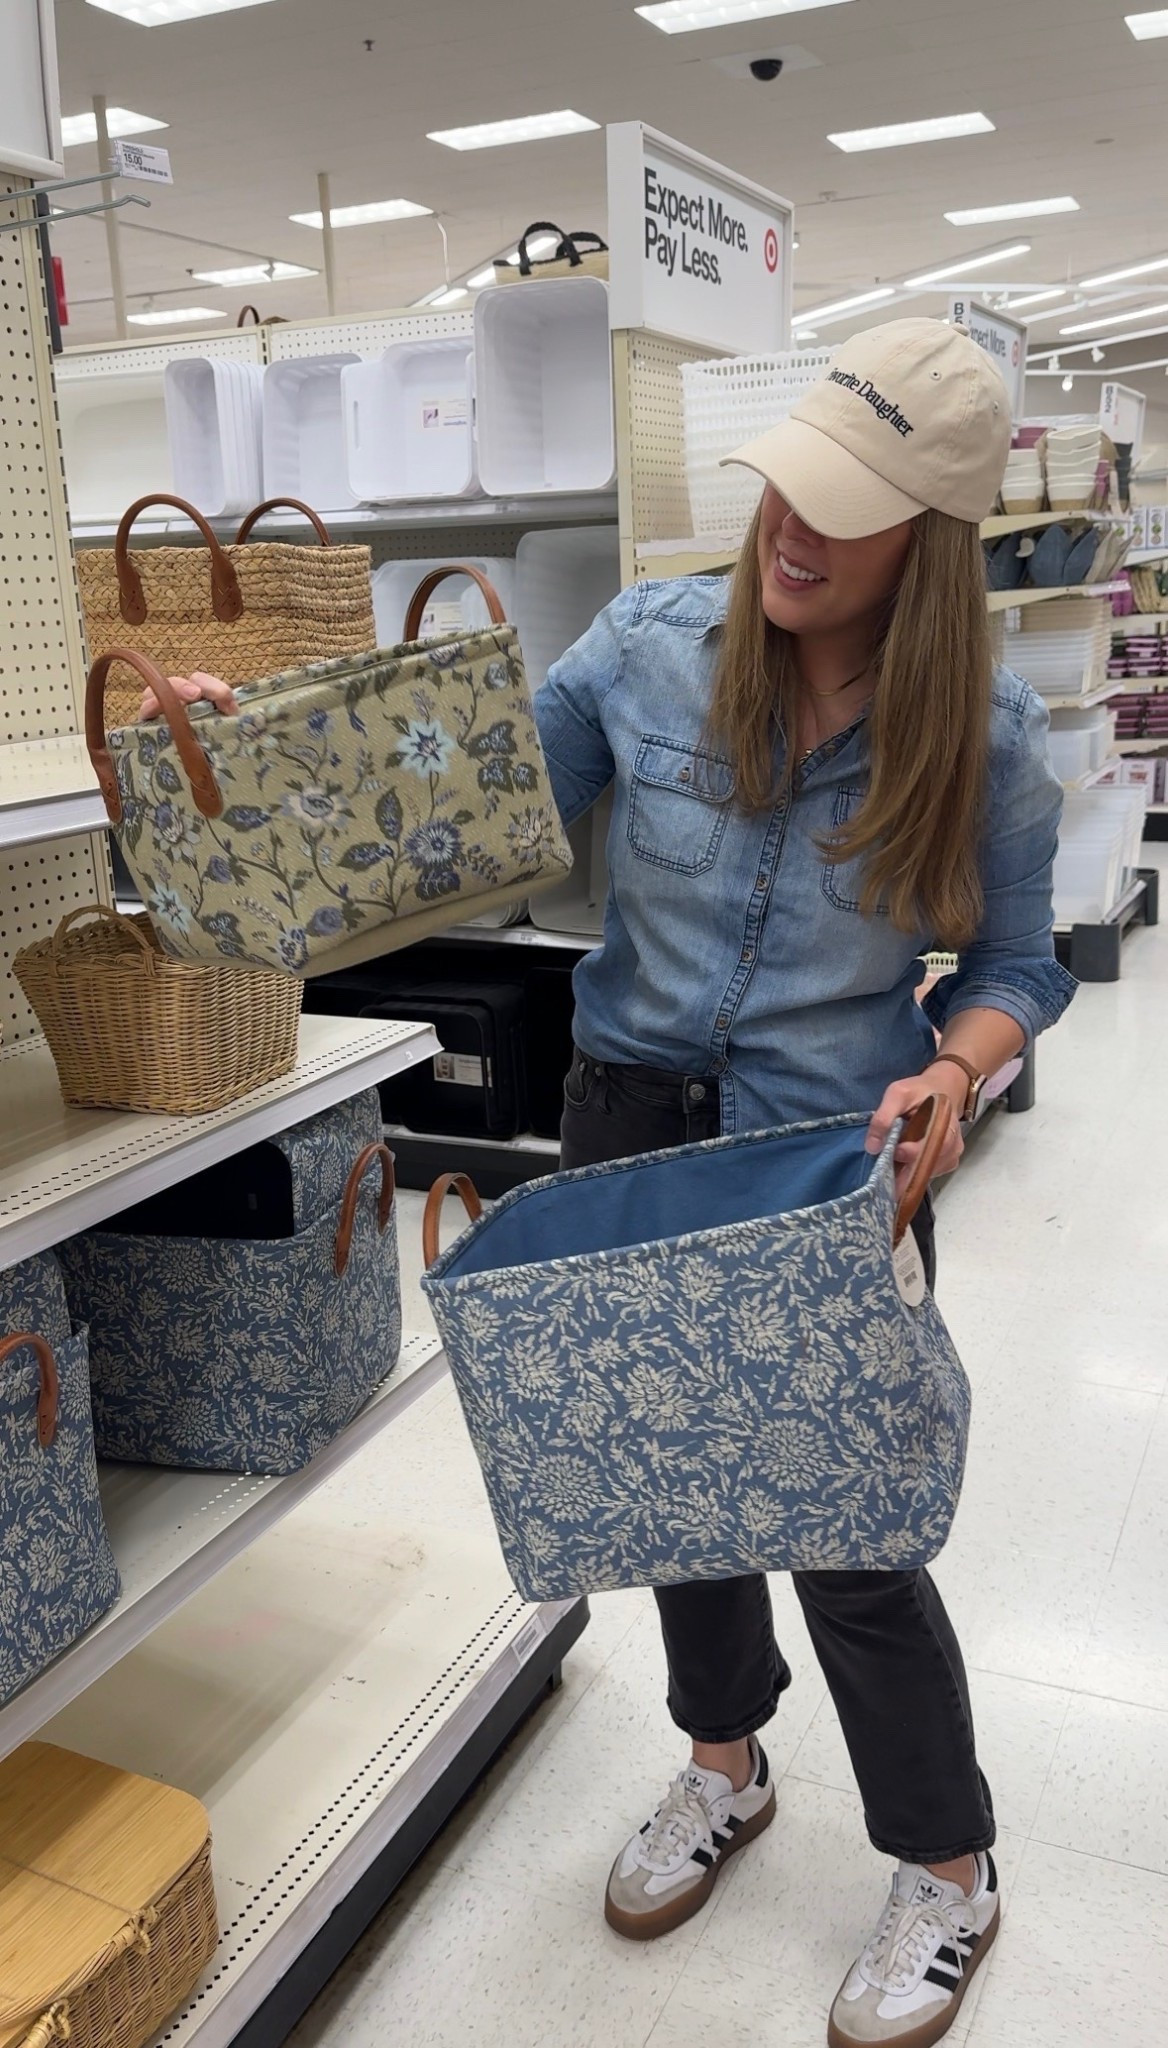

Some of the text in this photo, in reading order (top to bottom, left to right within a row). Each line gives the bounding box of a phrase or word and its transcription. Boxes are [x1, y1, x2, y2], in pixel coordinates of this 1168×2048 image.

[123, 153, 143, 166] 15.00
[644, 166, 748, 253] Expect More.
[645, 216, 722, 285] Pay Less.
[856, 380, 914, 437] Daughter
